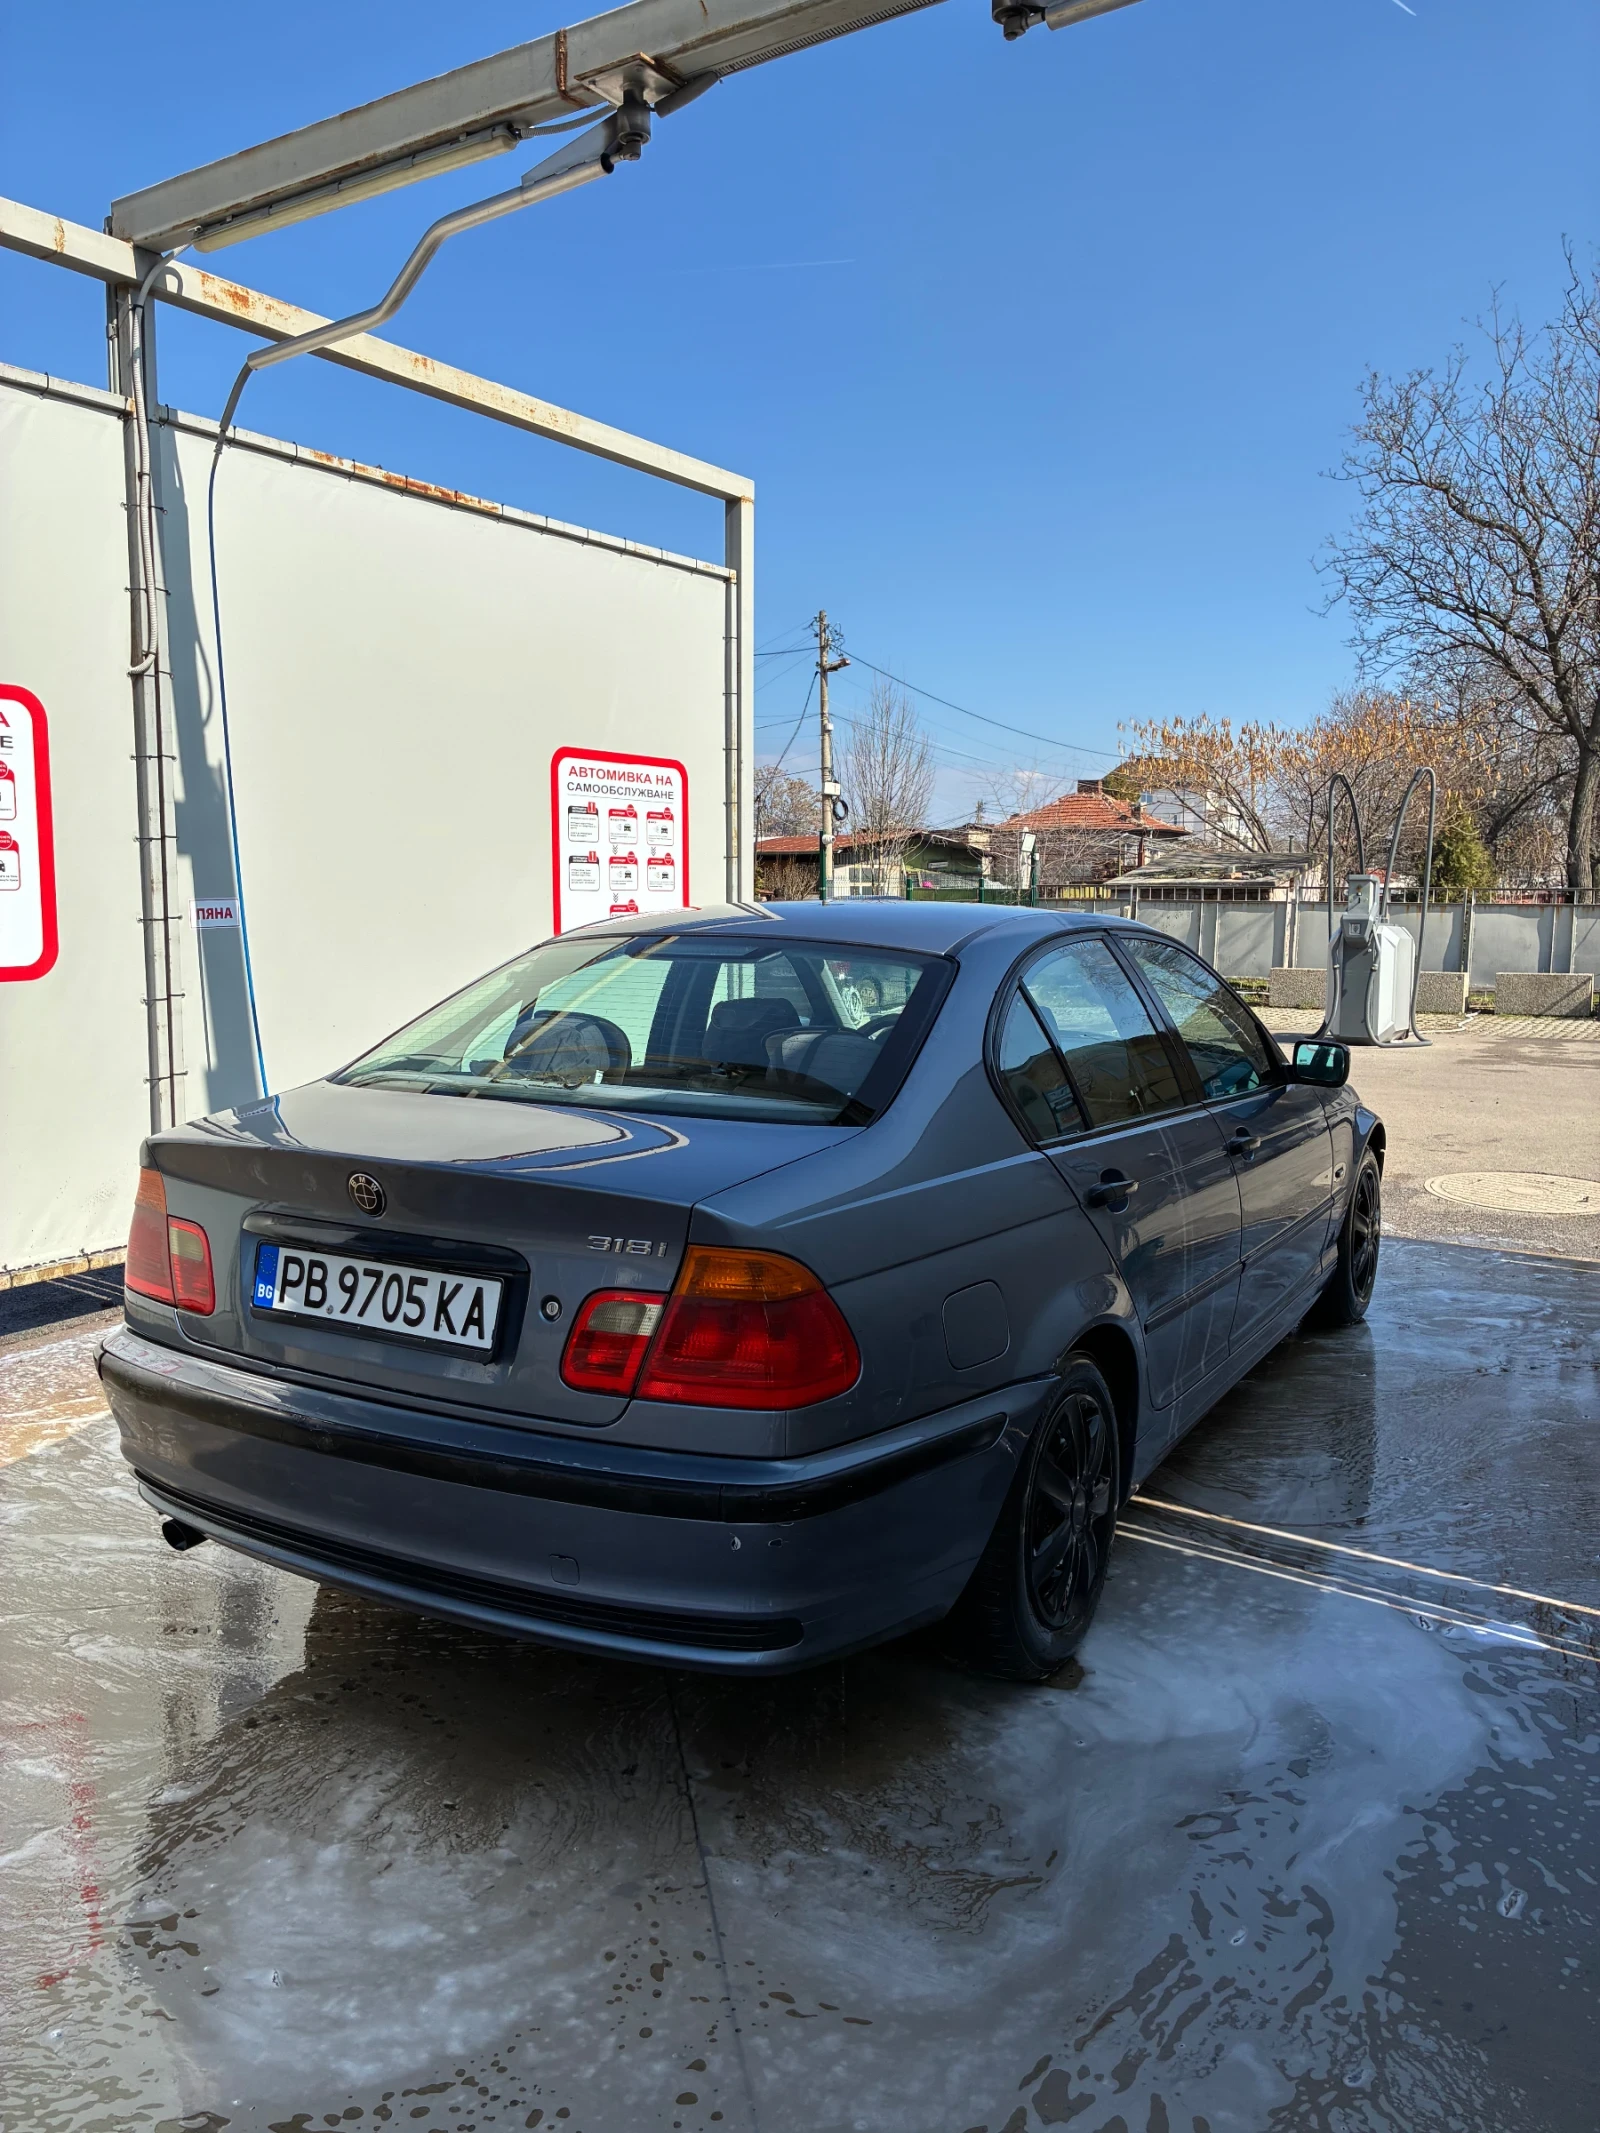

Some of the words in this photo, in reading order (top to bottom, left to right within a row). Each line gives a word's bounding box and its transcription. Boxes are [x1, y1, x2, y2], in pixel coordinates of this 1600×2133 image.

[568, 766, 652, 785] АВТОМИВКА
[655, 774, 674, 787] НА
[566, 781, 675, 800] САМООБСЛУЖВАНЕ
[196, 907, 233, 920] ПЯНА
[350, 1176, 379, 1192] BMW
[586, 1235, 668, 1257] 318i
[257, 1283, 273, 1300] BG
